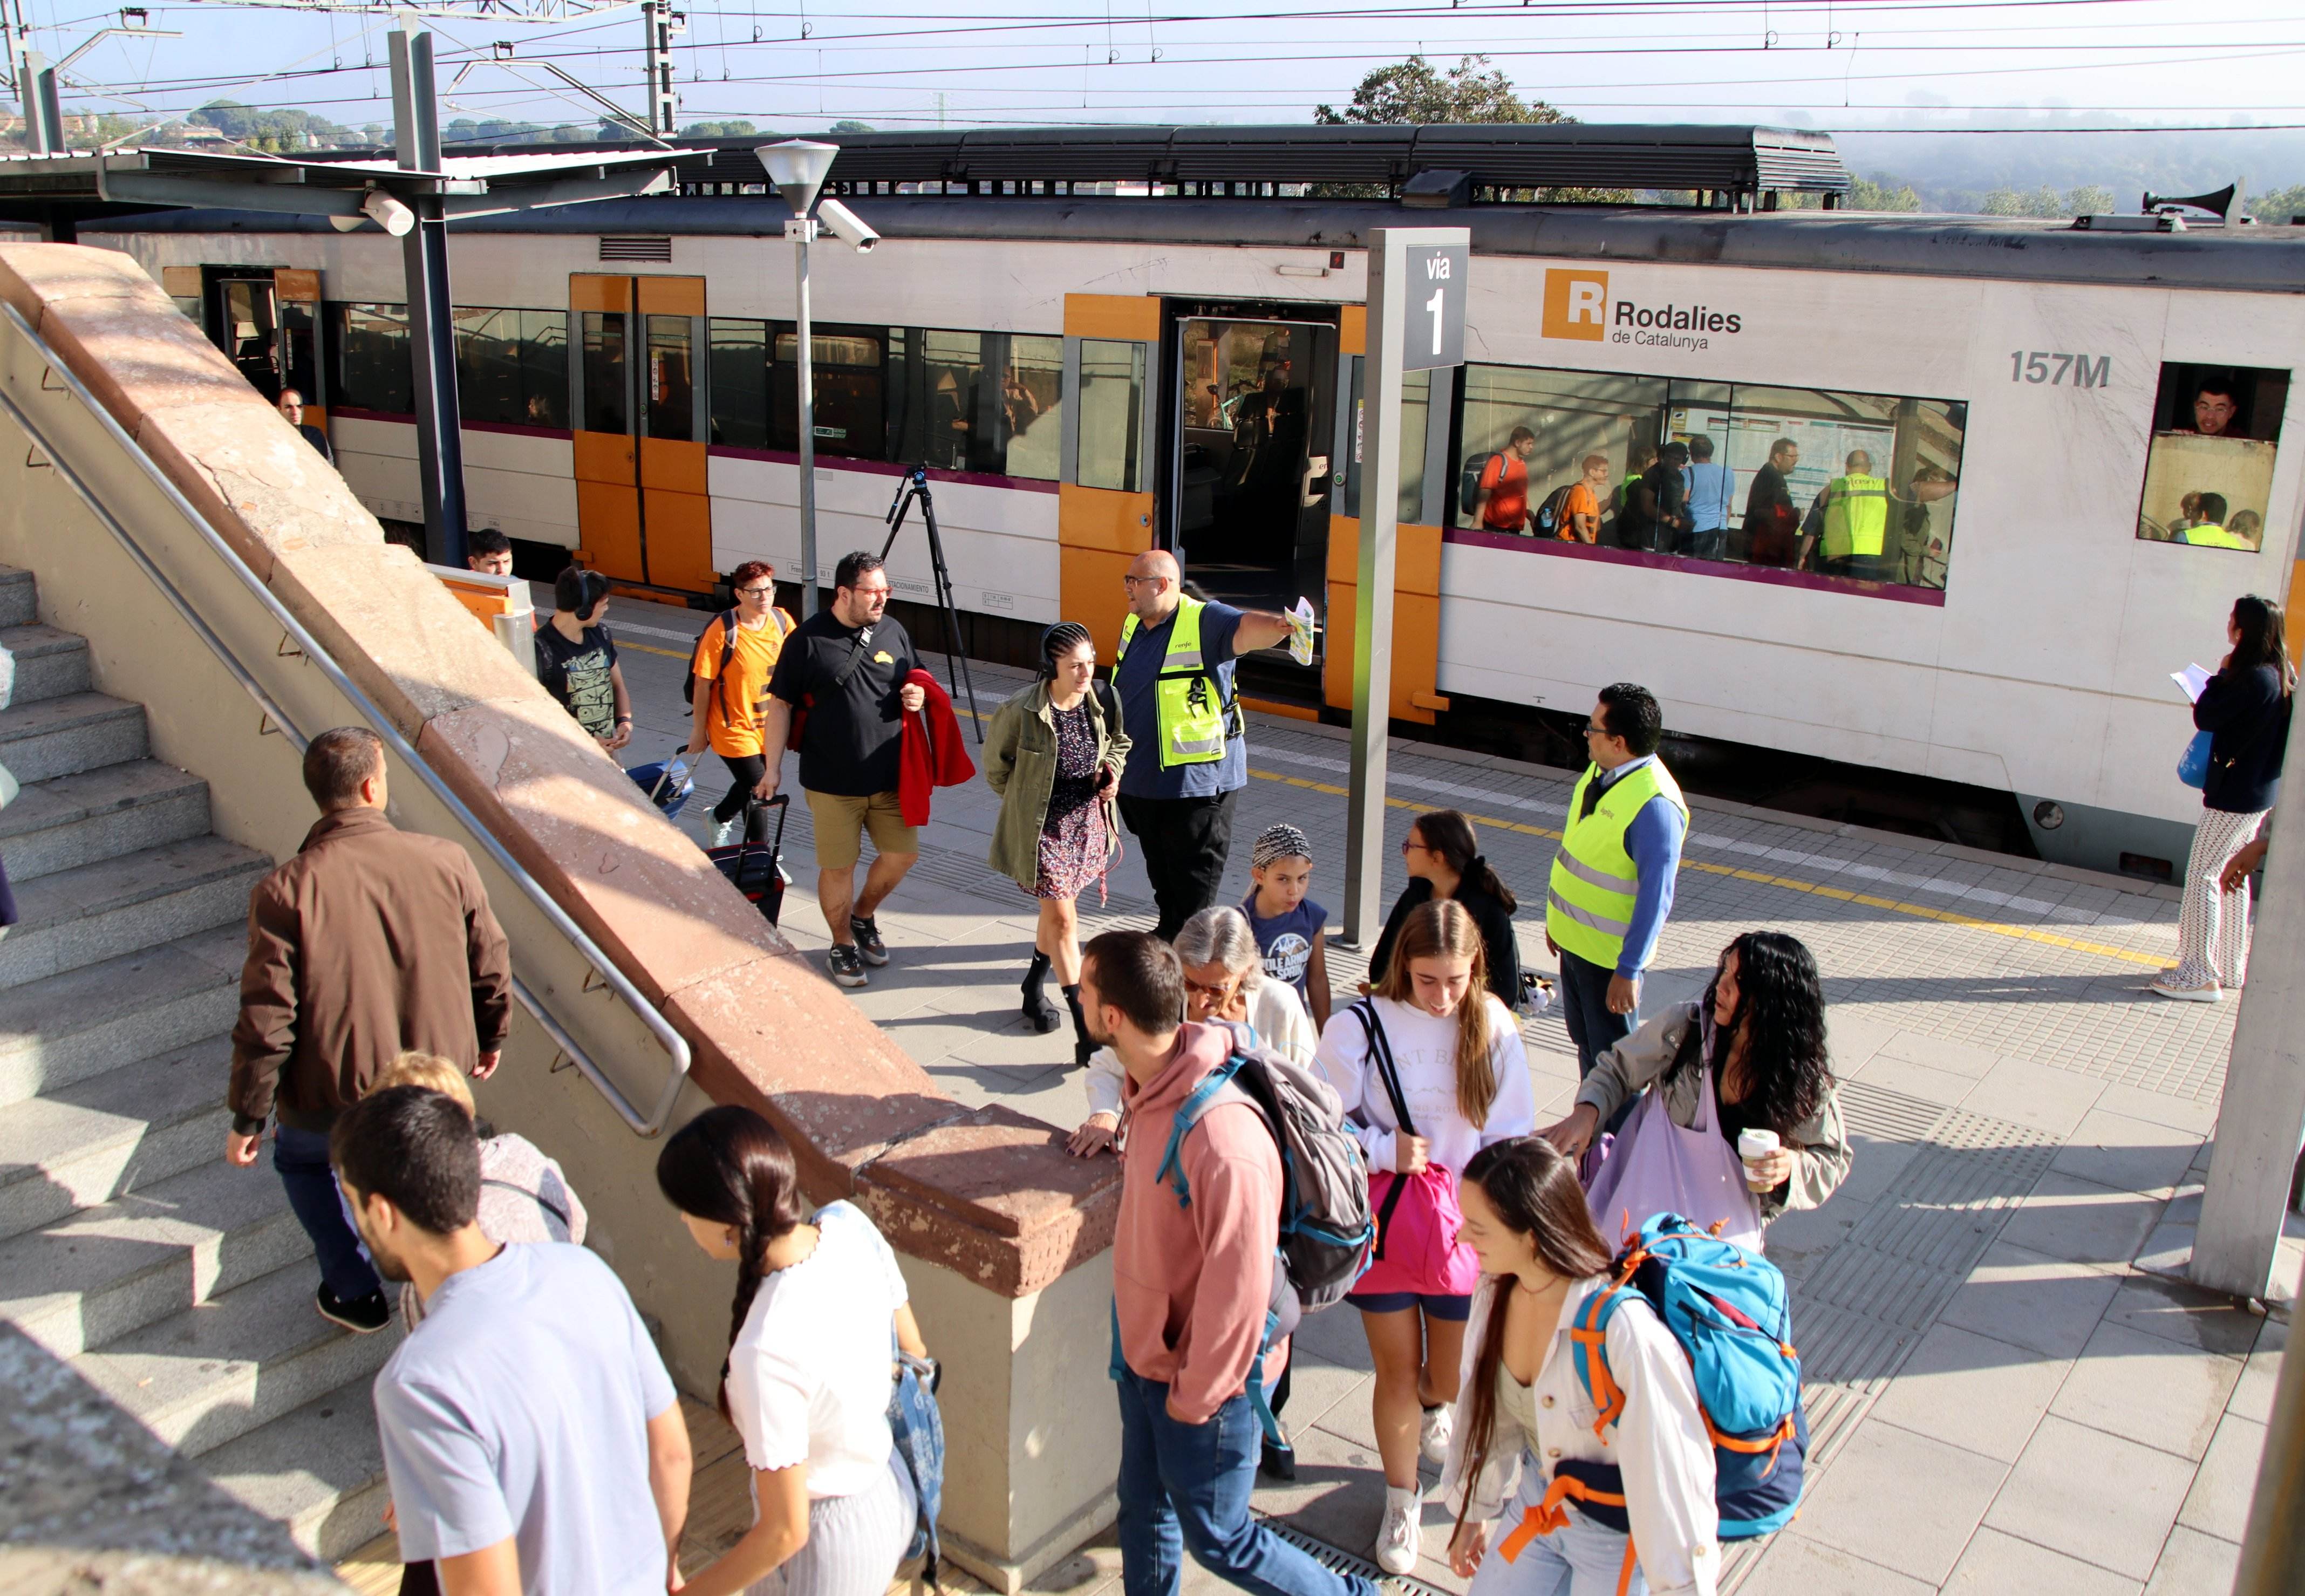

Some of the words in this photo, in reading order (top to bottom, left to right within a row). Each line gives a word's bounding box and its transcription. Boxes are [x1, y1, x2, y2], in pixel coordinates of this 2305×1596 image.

[1567, 281, 1605, 324] R
[1615, 301, 1742, 333] Rodalies
[1426, 289, 1443, 355] 1
[1612, 330, 1630, 344] de
[1635, 330, 1708, 352] Catalunya
[2011, 351, 2111, 388] 157M
[1175, 640, 1191, 649] renfe
